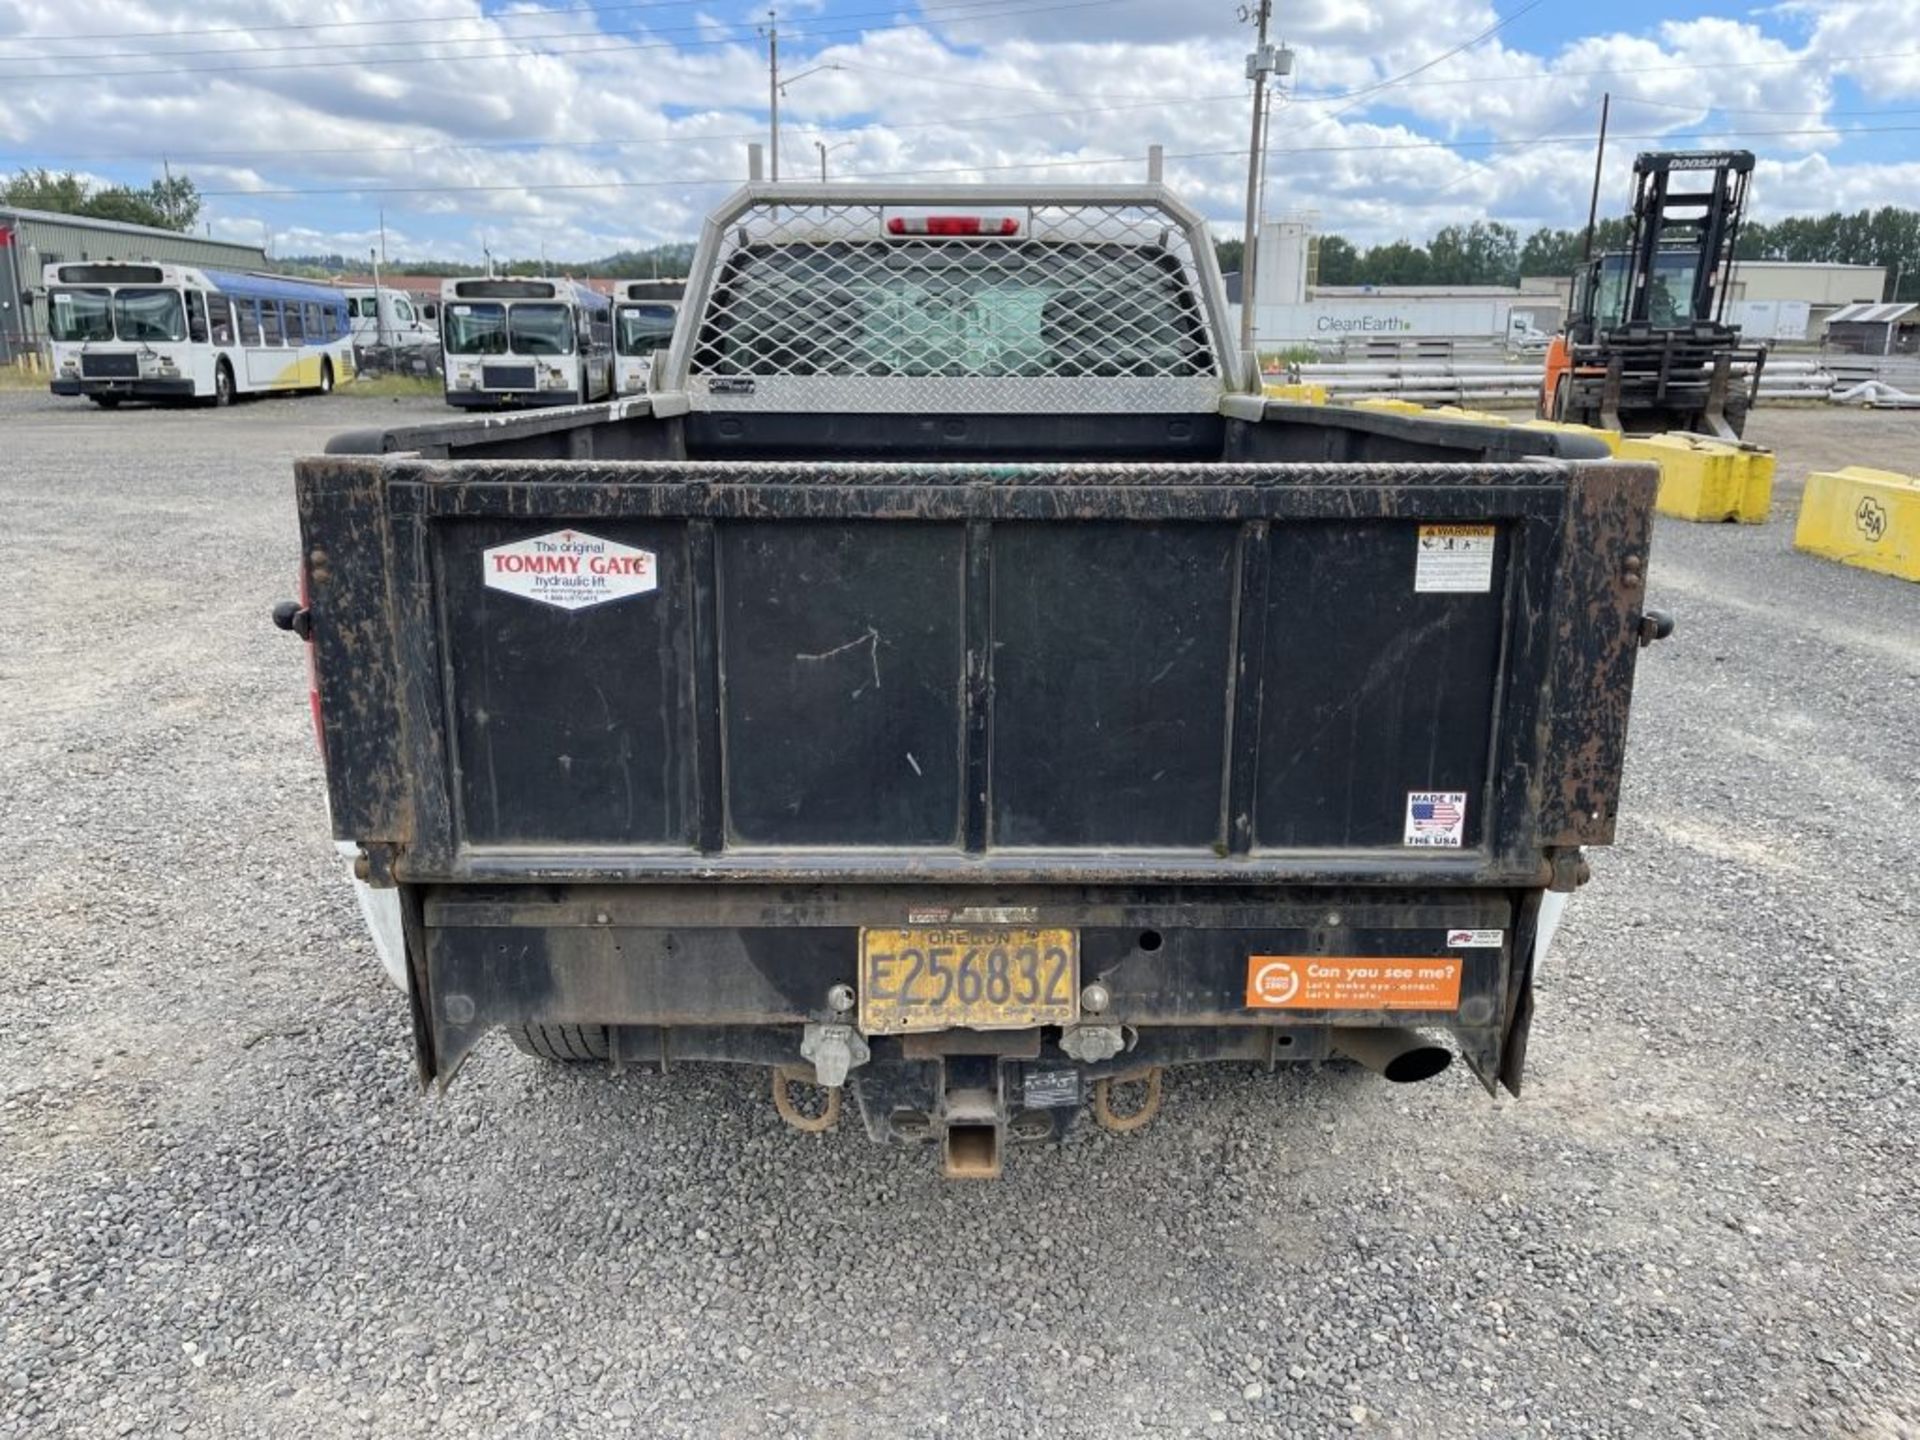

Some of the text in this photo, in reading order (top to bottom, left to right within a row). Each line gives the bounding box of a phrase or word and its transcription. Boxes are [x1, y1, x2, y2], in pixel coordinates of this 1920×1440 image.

[1668, 158, 1730, 168] DOOSAN
[1438, 528, 1490, 536] WARNING
[534, 541, 605, 555] The original
[493, 555, 646, 574] TOMMY GATE
[535, 575, 606, 588] hydraulic lift
[1411, 794, 1463, 803] MADE IN
[1408, 836, 1458, 845] THE USA
[928, 931, 1011, 945] OREGON
[870, 947, 1069, 1006] E256832
[1307, 964, 1455, 982] Can you see me?
[1306, 981, 1330, 990] Let's
[1336, 982, 1366, 990] make
[1370, 984, 1390, 992] eye
[1305, 991, 1330, 999] Let's
[1334, 991, 1348, 999] be
